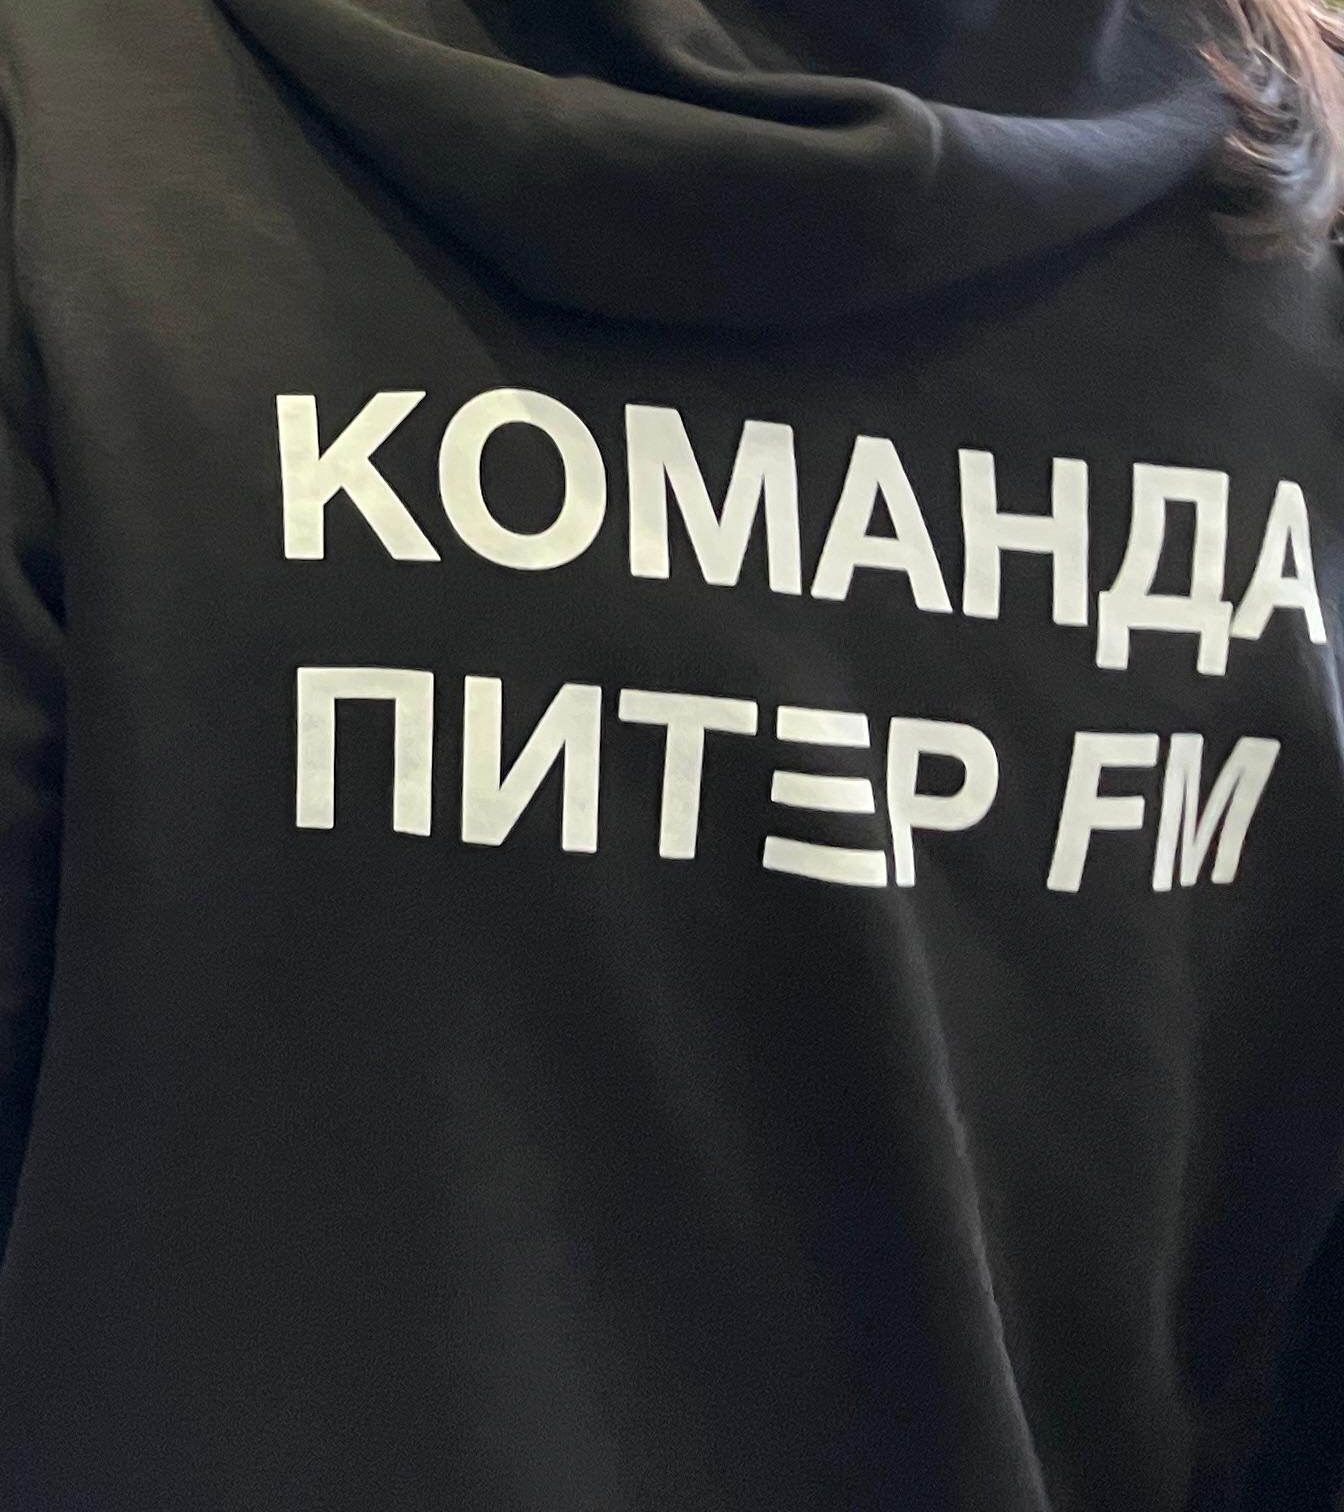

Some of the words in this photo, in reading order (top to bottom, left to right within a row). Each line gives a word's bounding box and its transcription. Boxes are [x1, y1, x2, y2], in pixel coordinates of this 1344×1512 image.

[275, 386, 1327, 676] КОМАНДА
[295, 665, 1000, 888] ПИТЕР
[1045, 731, 1280, 893] FM
